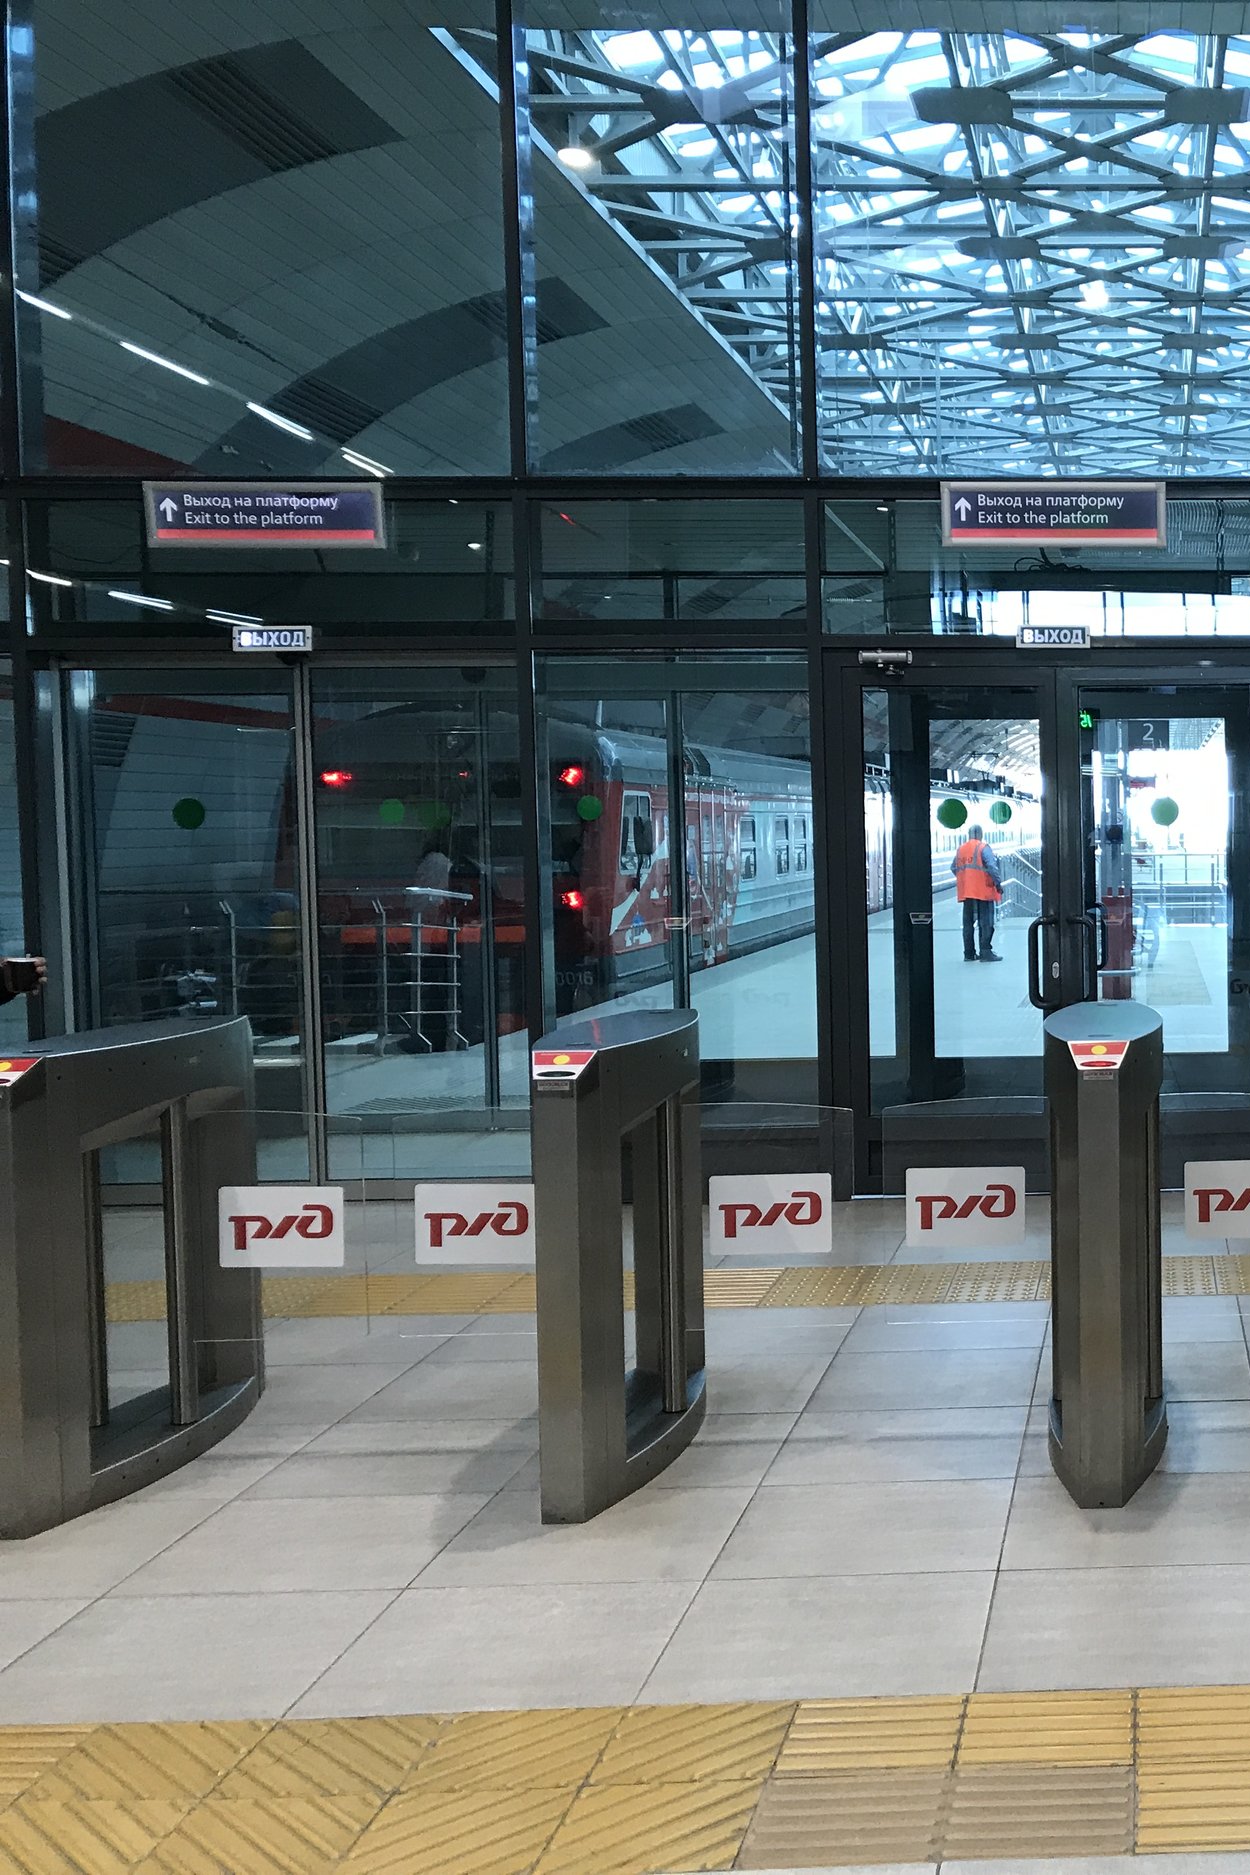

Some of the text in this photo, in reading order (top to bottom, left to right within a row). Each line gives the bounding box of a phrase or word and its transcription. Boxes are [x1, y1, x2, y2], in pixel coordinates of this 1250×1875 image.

[183, 494, 338, 510] Выход на платформу
[977, 494, 1124, 510] Выход на платформу
[185, 511, 323, 527] Exit to the platform
[978, 511, 1109, 527] Exit to the platform
[1023, 629, 1084, 644] ВЫХОД
[1142, 723, 1154, 741] 2
